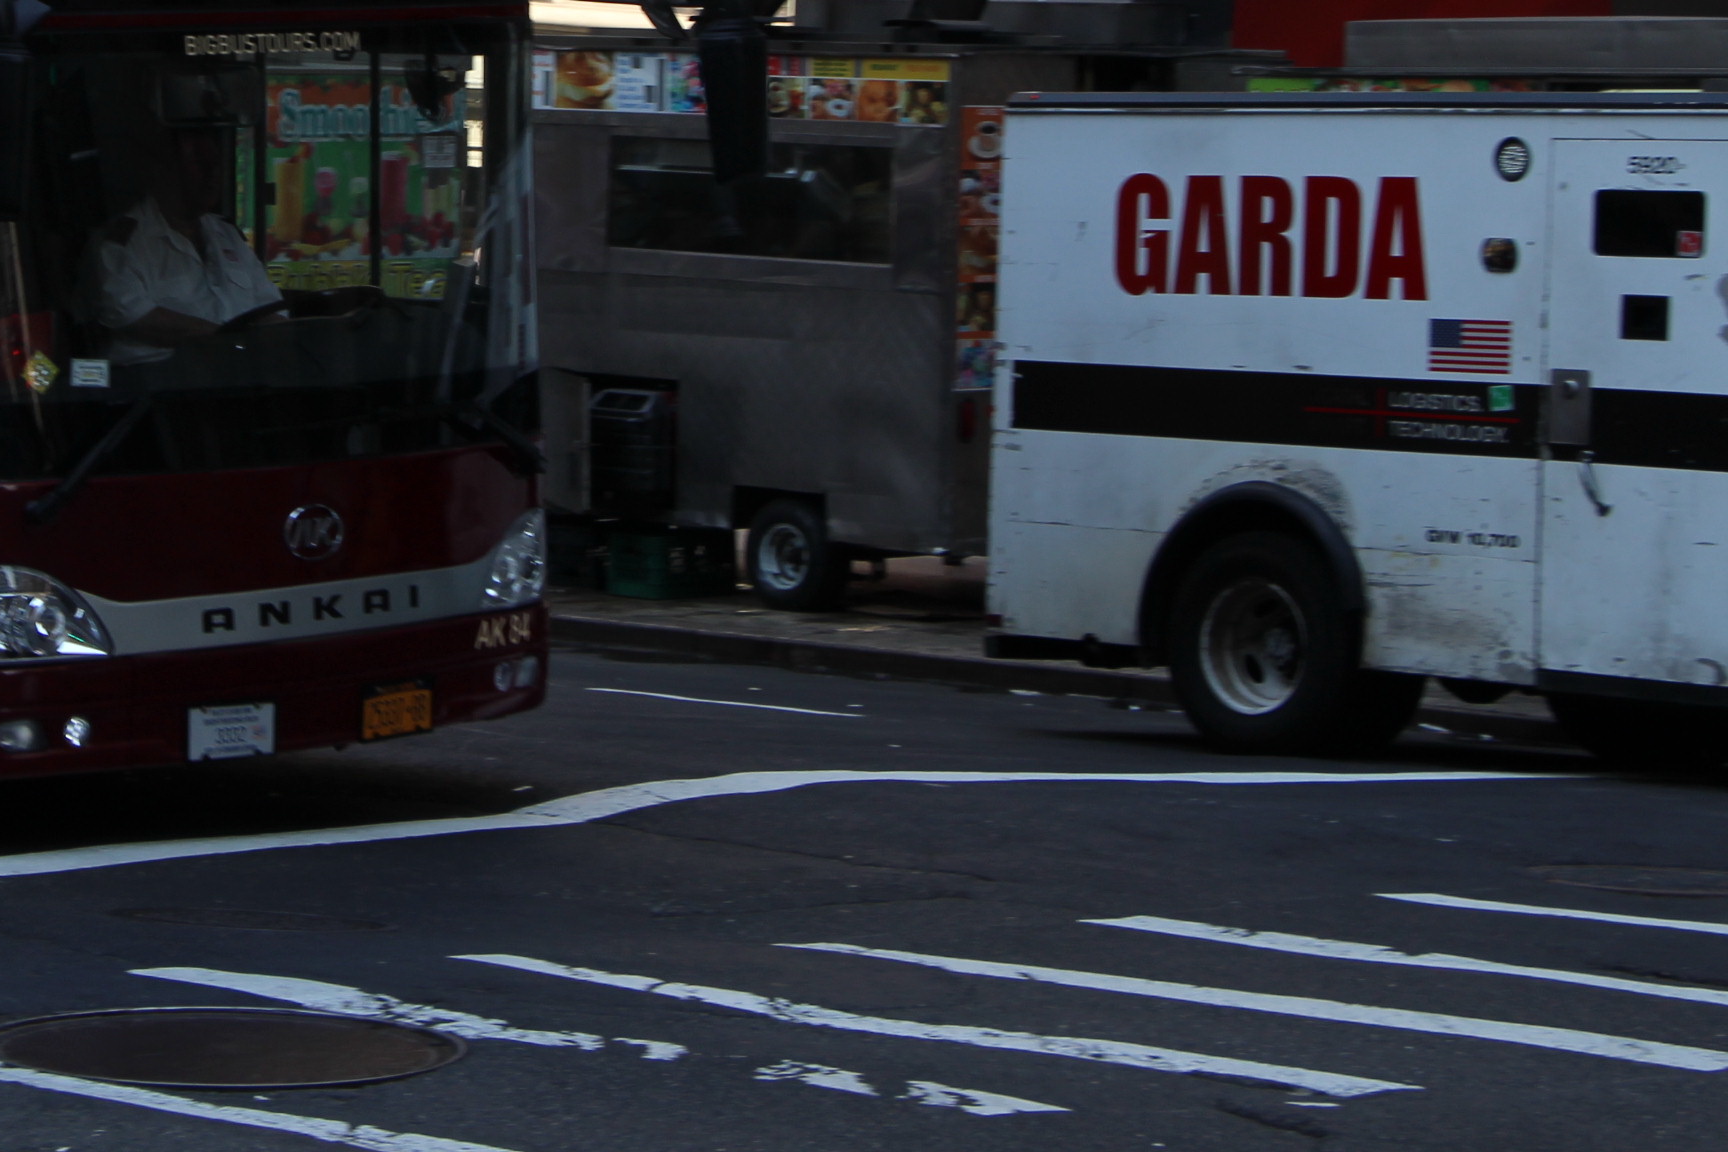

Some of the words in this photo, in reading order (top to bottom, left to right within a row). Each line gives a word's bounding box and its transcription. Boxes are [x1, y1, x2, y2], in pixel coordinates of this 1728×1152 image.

[183, 30, 362, 56] BIGBUSTOURS.COM
[1117, 173, 1428, 301] GARDA
[202, 585, 420, 634] ANKAI
[474, 619, 507, 650] AK
[508, 613, 532, 645] 84
